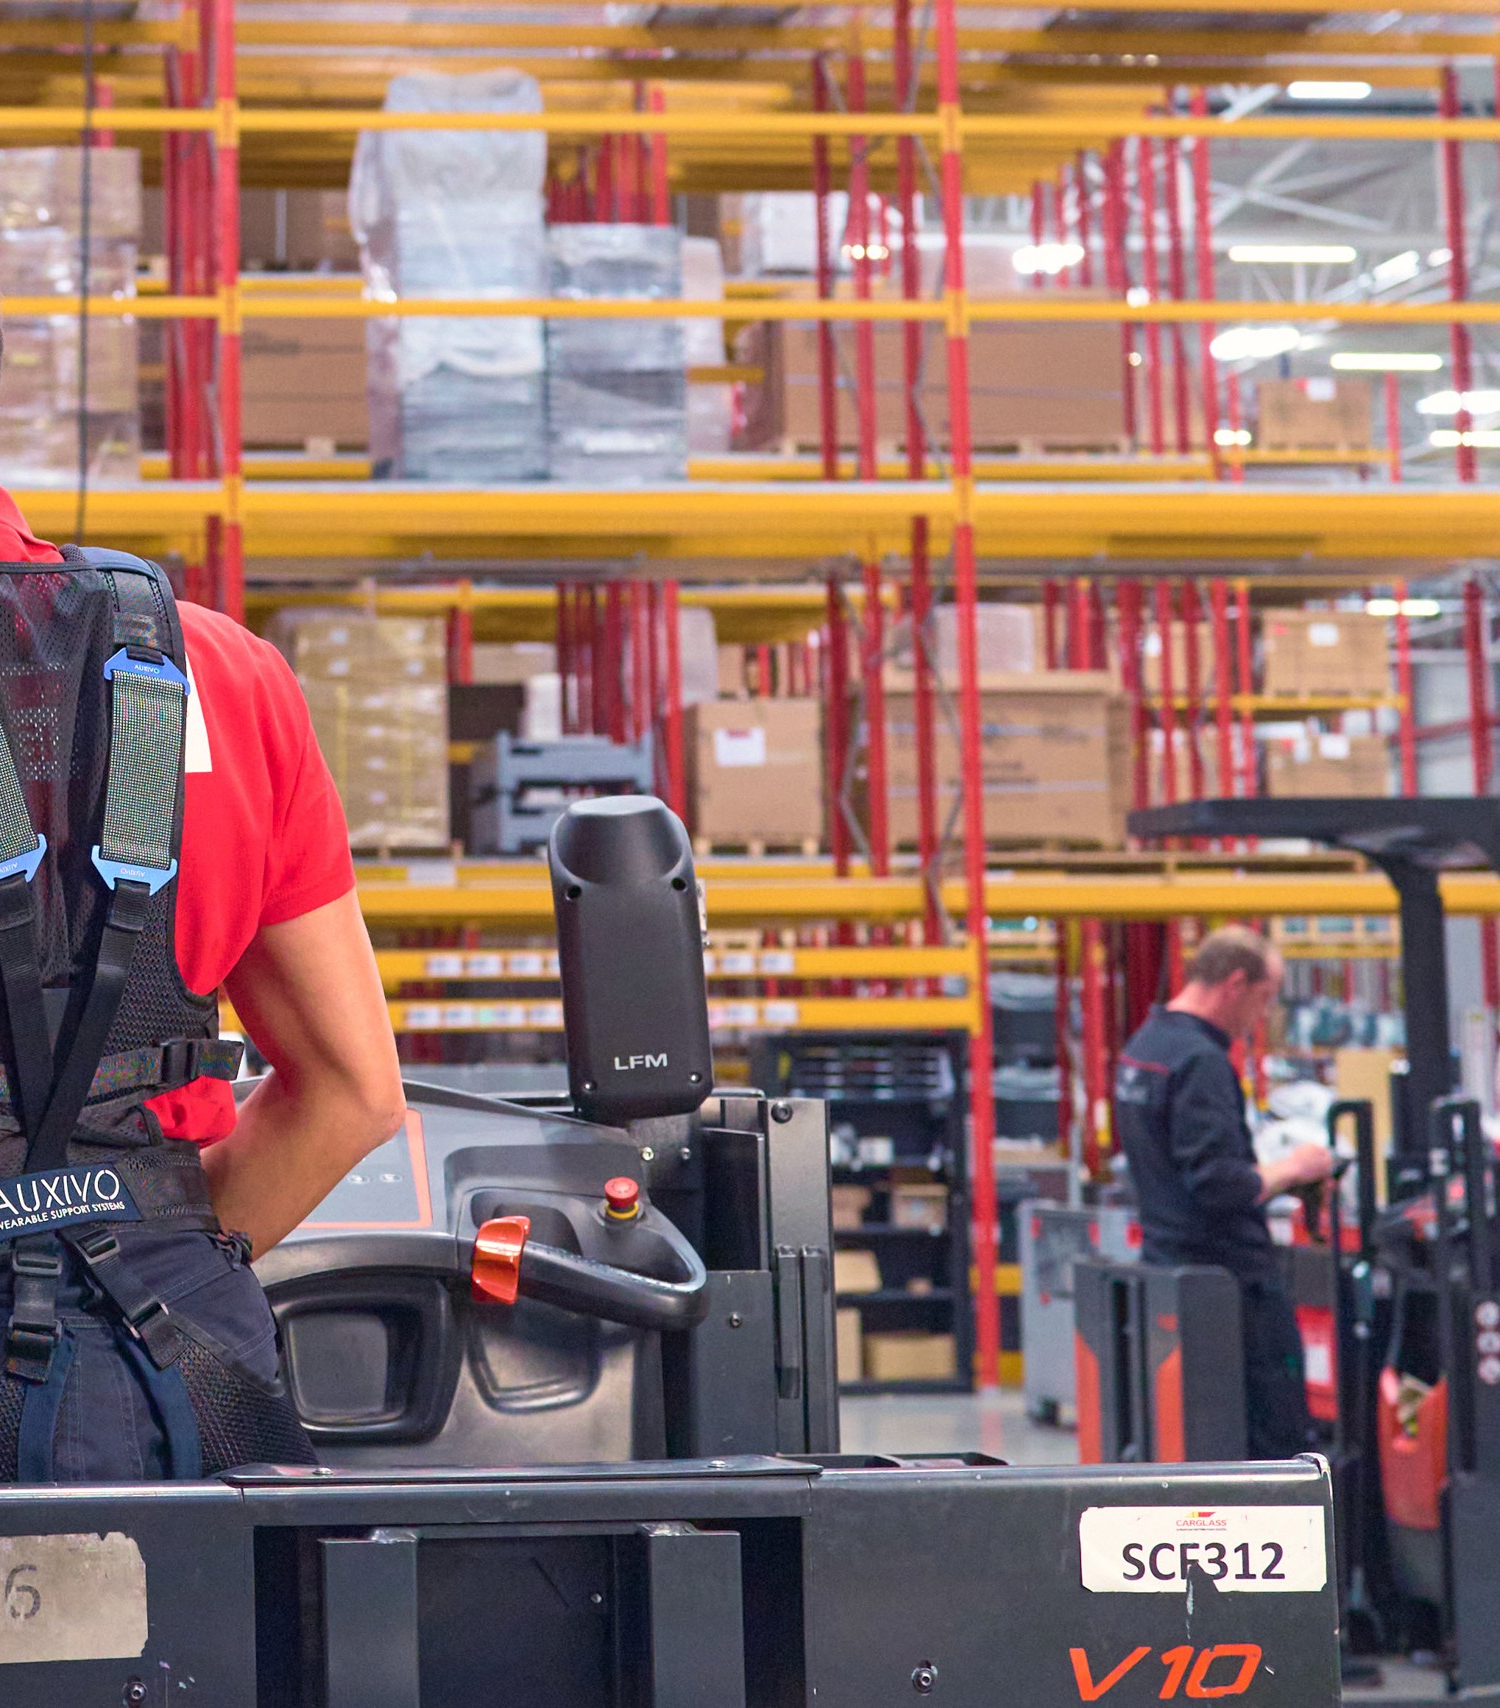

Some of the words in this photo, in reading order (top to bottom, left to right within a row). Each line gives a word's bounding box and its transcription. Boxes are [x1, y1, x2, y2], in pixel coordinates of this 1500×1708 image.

[134, 664, 160, 674] AUXIVO
[614, 1053, 668, 1071] LFM
[50, 1204, 91, 1220] SUPPORT
[92, 1200, 126, 1213] SYSTEMS
[1175, 1519, 1227, 1527] CARGLASS
[5, 1563, 41, 1620] 6
